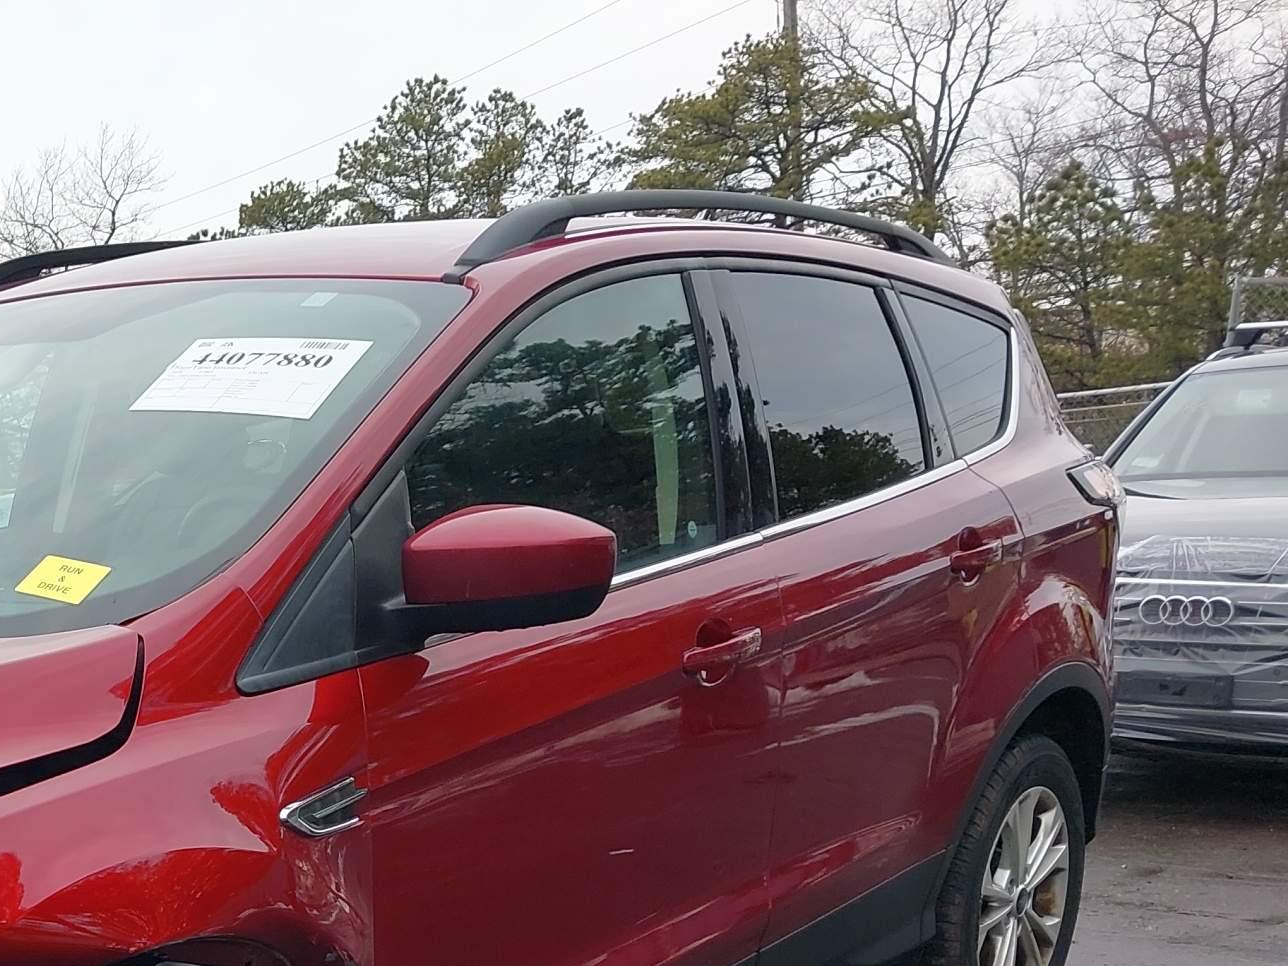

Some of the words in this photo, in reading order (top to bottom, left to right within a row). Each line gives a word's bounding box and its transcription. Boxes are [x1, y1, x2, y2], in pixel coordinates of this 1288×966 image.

[192, 351, 334, 369] 44077880
[58, 564, 85, 575] RUN
[57, 575, 66, 583] &
[36, 581, 73, 594] DRIVE
